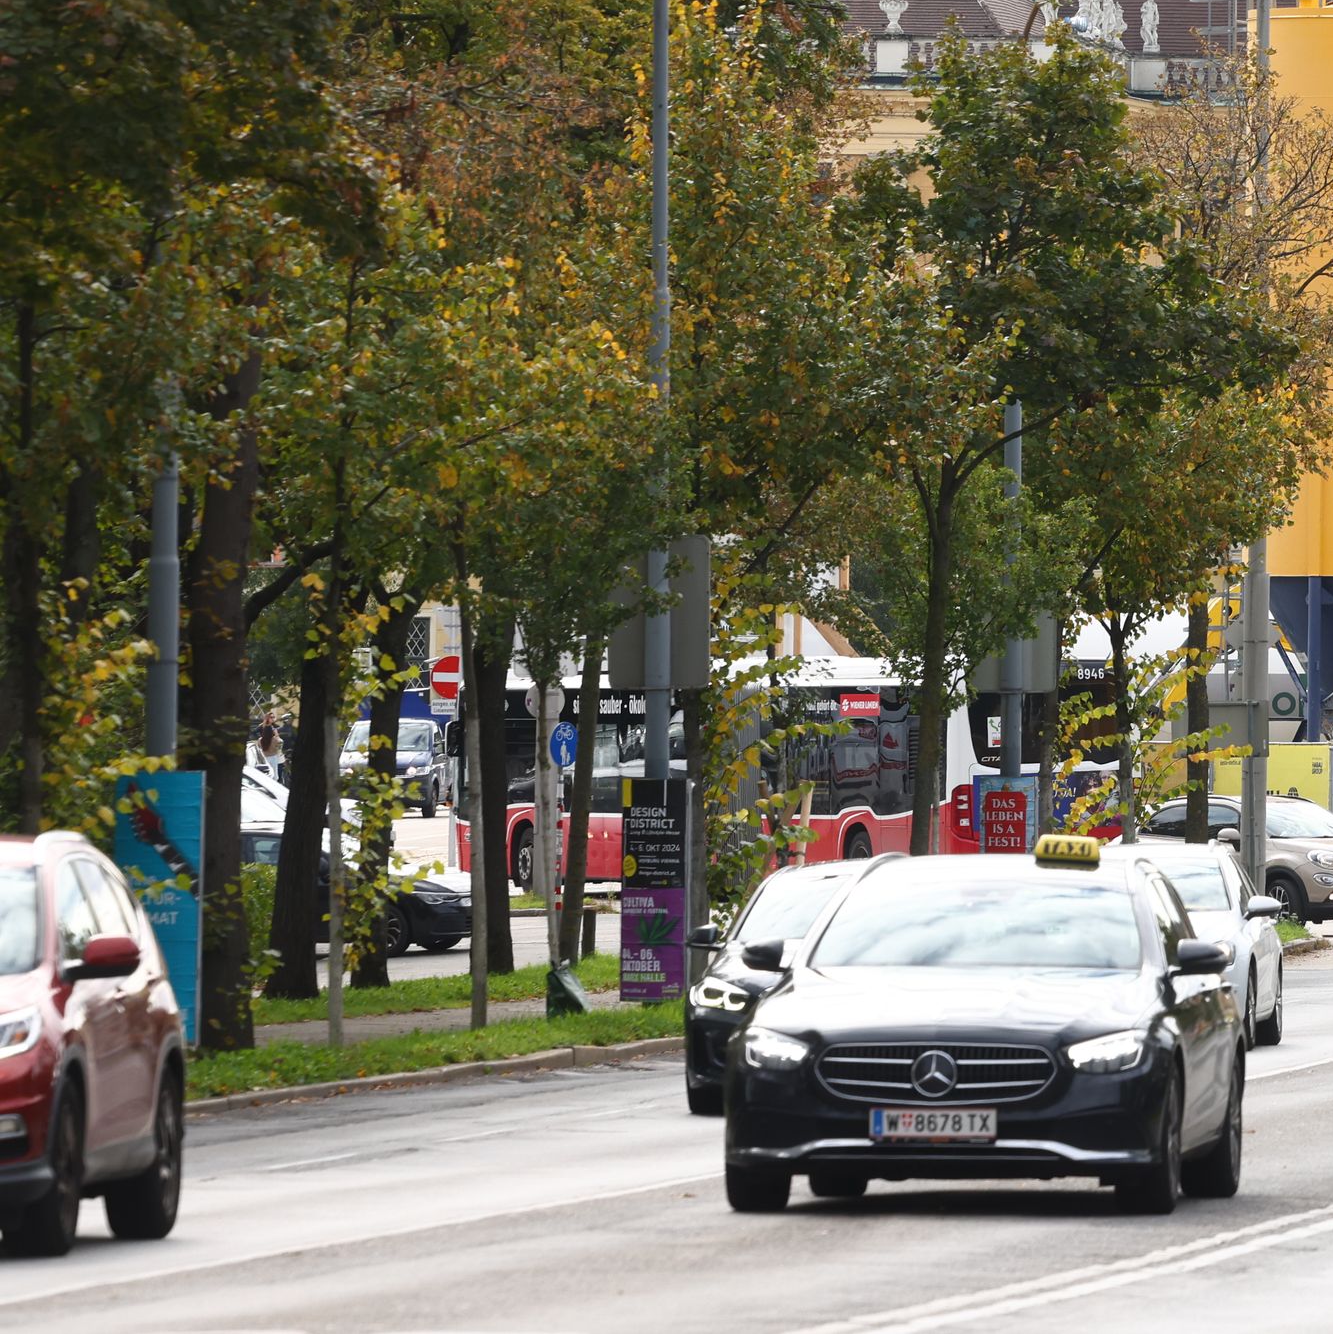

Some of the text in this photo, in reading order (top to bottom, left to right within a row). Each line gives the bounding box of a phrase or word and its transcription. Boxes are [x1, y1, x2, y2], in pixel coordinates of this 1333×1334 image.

[1077, 668, 1104, 680] 8946
[600, 695, 622, 714] sauber
[992, 798, 1016, 809] DAS
[630, 807, 667, 817] DESIGN
[986, 811, 1024, 821] LEBEN
[630, 819, 675, 829] DISTRICT
[992, 824, 1015, 834] IS A
[646, 844, 660, 852] OKT
[662, 844, 680, 852] 2024
[988, 837, 1021, 848] FEST!
[1043, 841, 1092, 856] TAXI
[623, 897, 654, 908] CULTIVA
[623, 961, 660, 972] OKTOBER
[641, 973, 666, 983] HALLE
[887, 1113, 991, 1133] W 8678 TX
